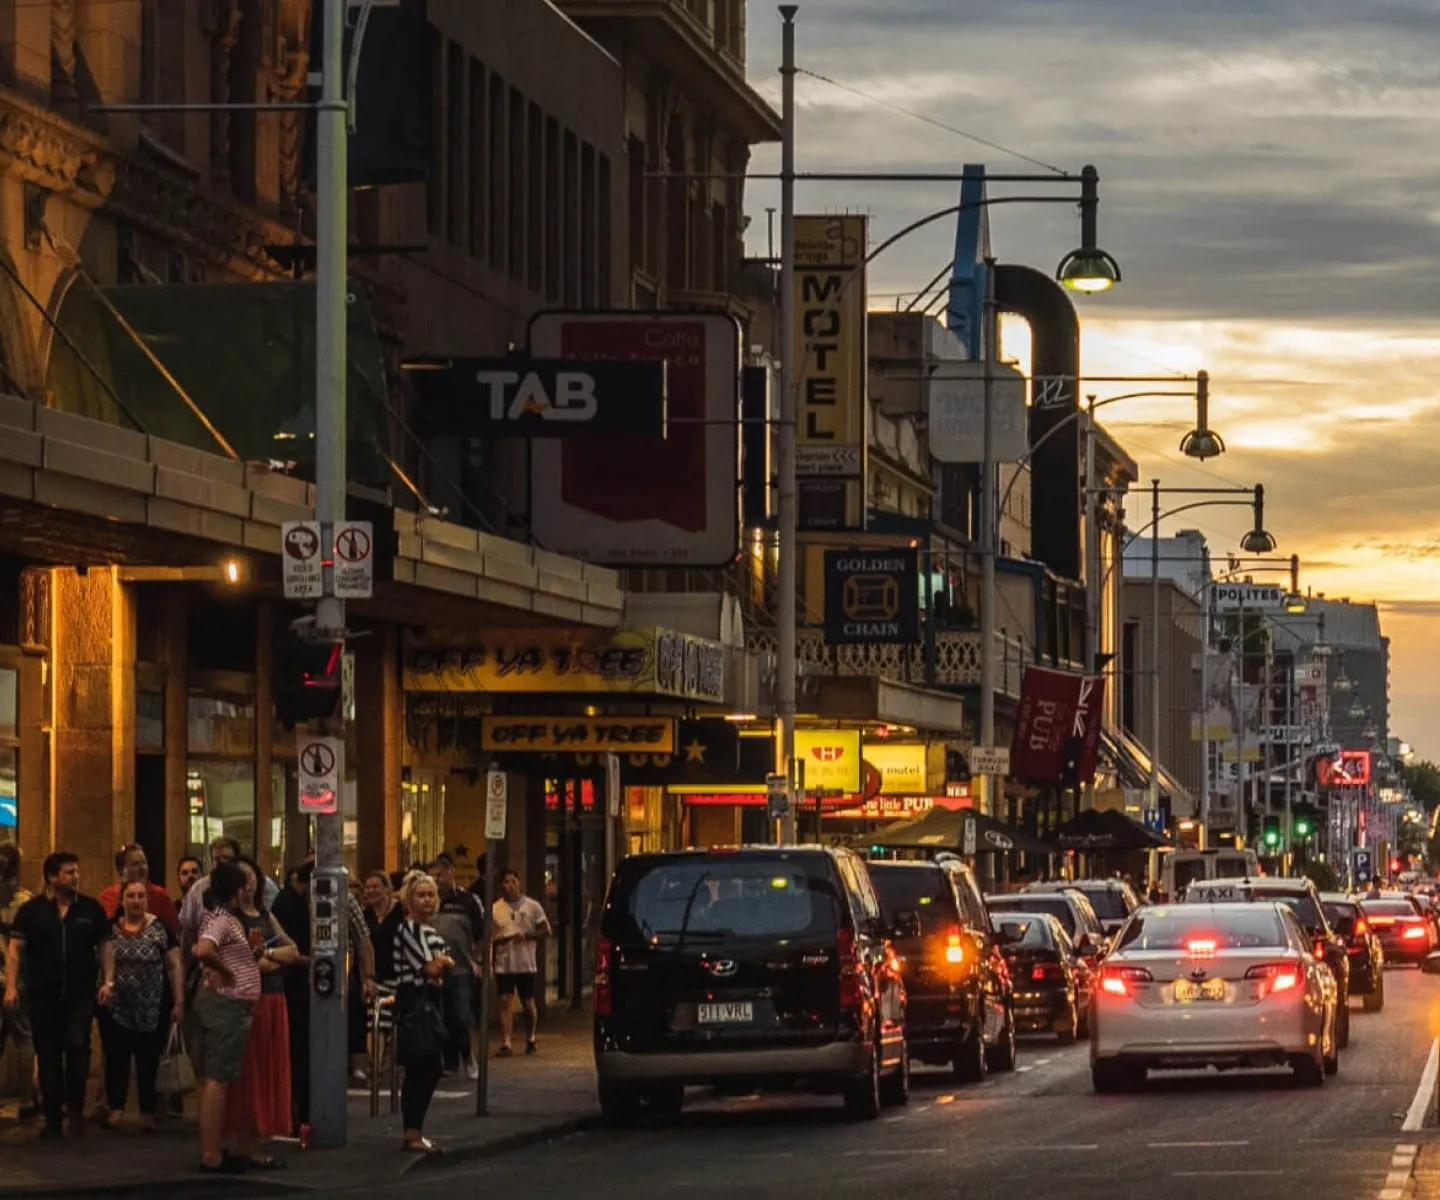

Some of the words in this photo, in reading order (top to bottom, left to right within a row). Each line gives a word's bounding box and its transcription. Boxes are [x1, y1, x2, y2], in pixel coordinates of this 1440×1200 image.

[802, 275, 842, 439] MOTEL
[477, 371, 598, 421] TAB
[836, 558, 906, 572] GOLDEN
[1218, 588, 1279, 601] POLITES
[843, 622, 898, 636] CHAIN
[410, 647, 485, 674] OFF
[491, 725, 547, 745] OFF
[553, 725, 588, 743] YA
[594, 725, 666, 744] TREE
[1029, 699, 1056, 751] PUB
[1197, 888, 1233, 899] TAXI
